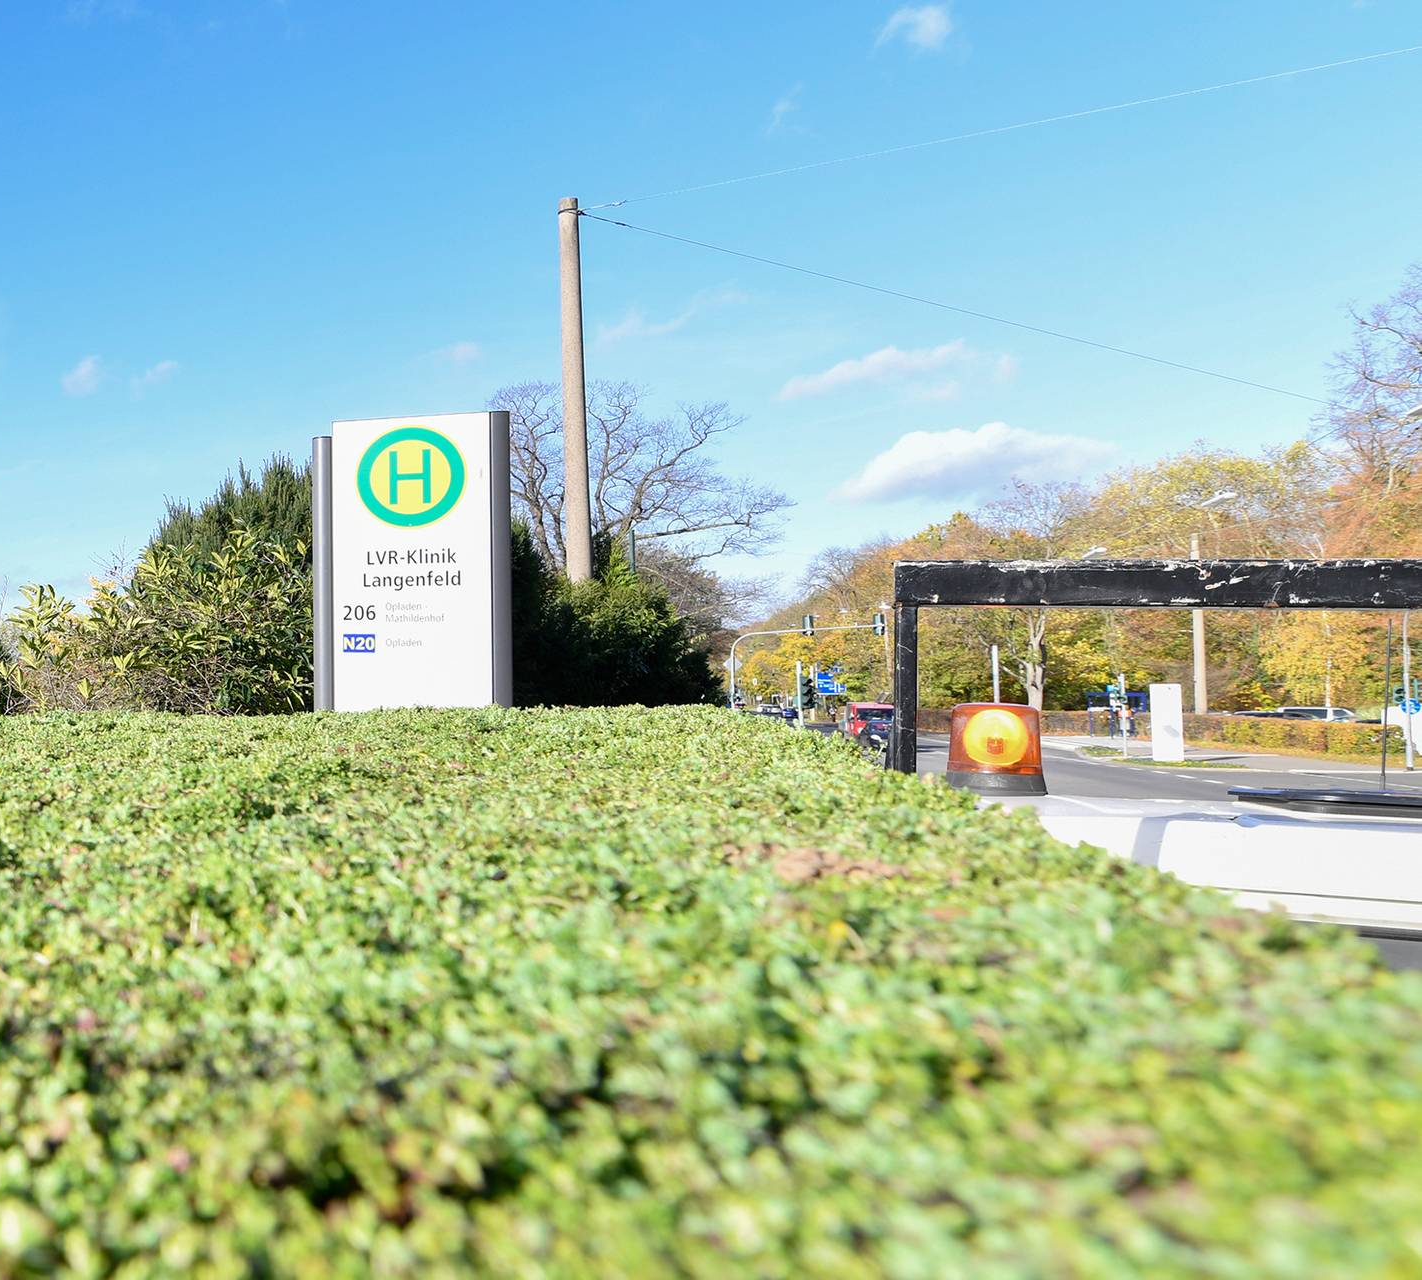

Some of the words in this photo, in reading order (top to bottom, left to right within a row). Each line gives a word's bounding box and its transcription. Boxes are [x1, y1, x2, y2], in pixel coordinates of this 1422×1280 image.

[388, 449, 431, 505] H
[366, 548, 457, 566] LVR-Klinik
[363, 570, 462, 591] Langenfeld
[343, 604, 377, 621] 206
[385, 602, 422, 612] Opladen
[385, 613, 445, 623] Mathildenhof
[343, 636, 376, 651] N20
[385, 638, 422, 648] Opladen
